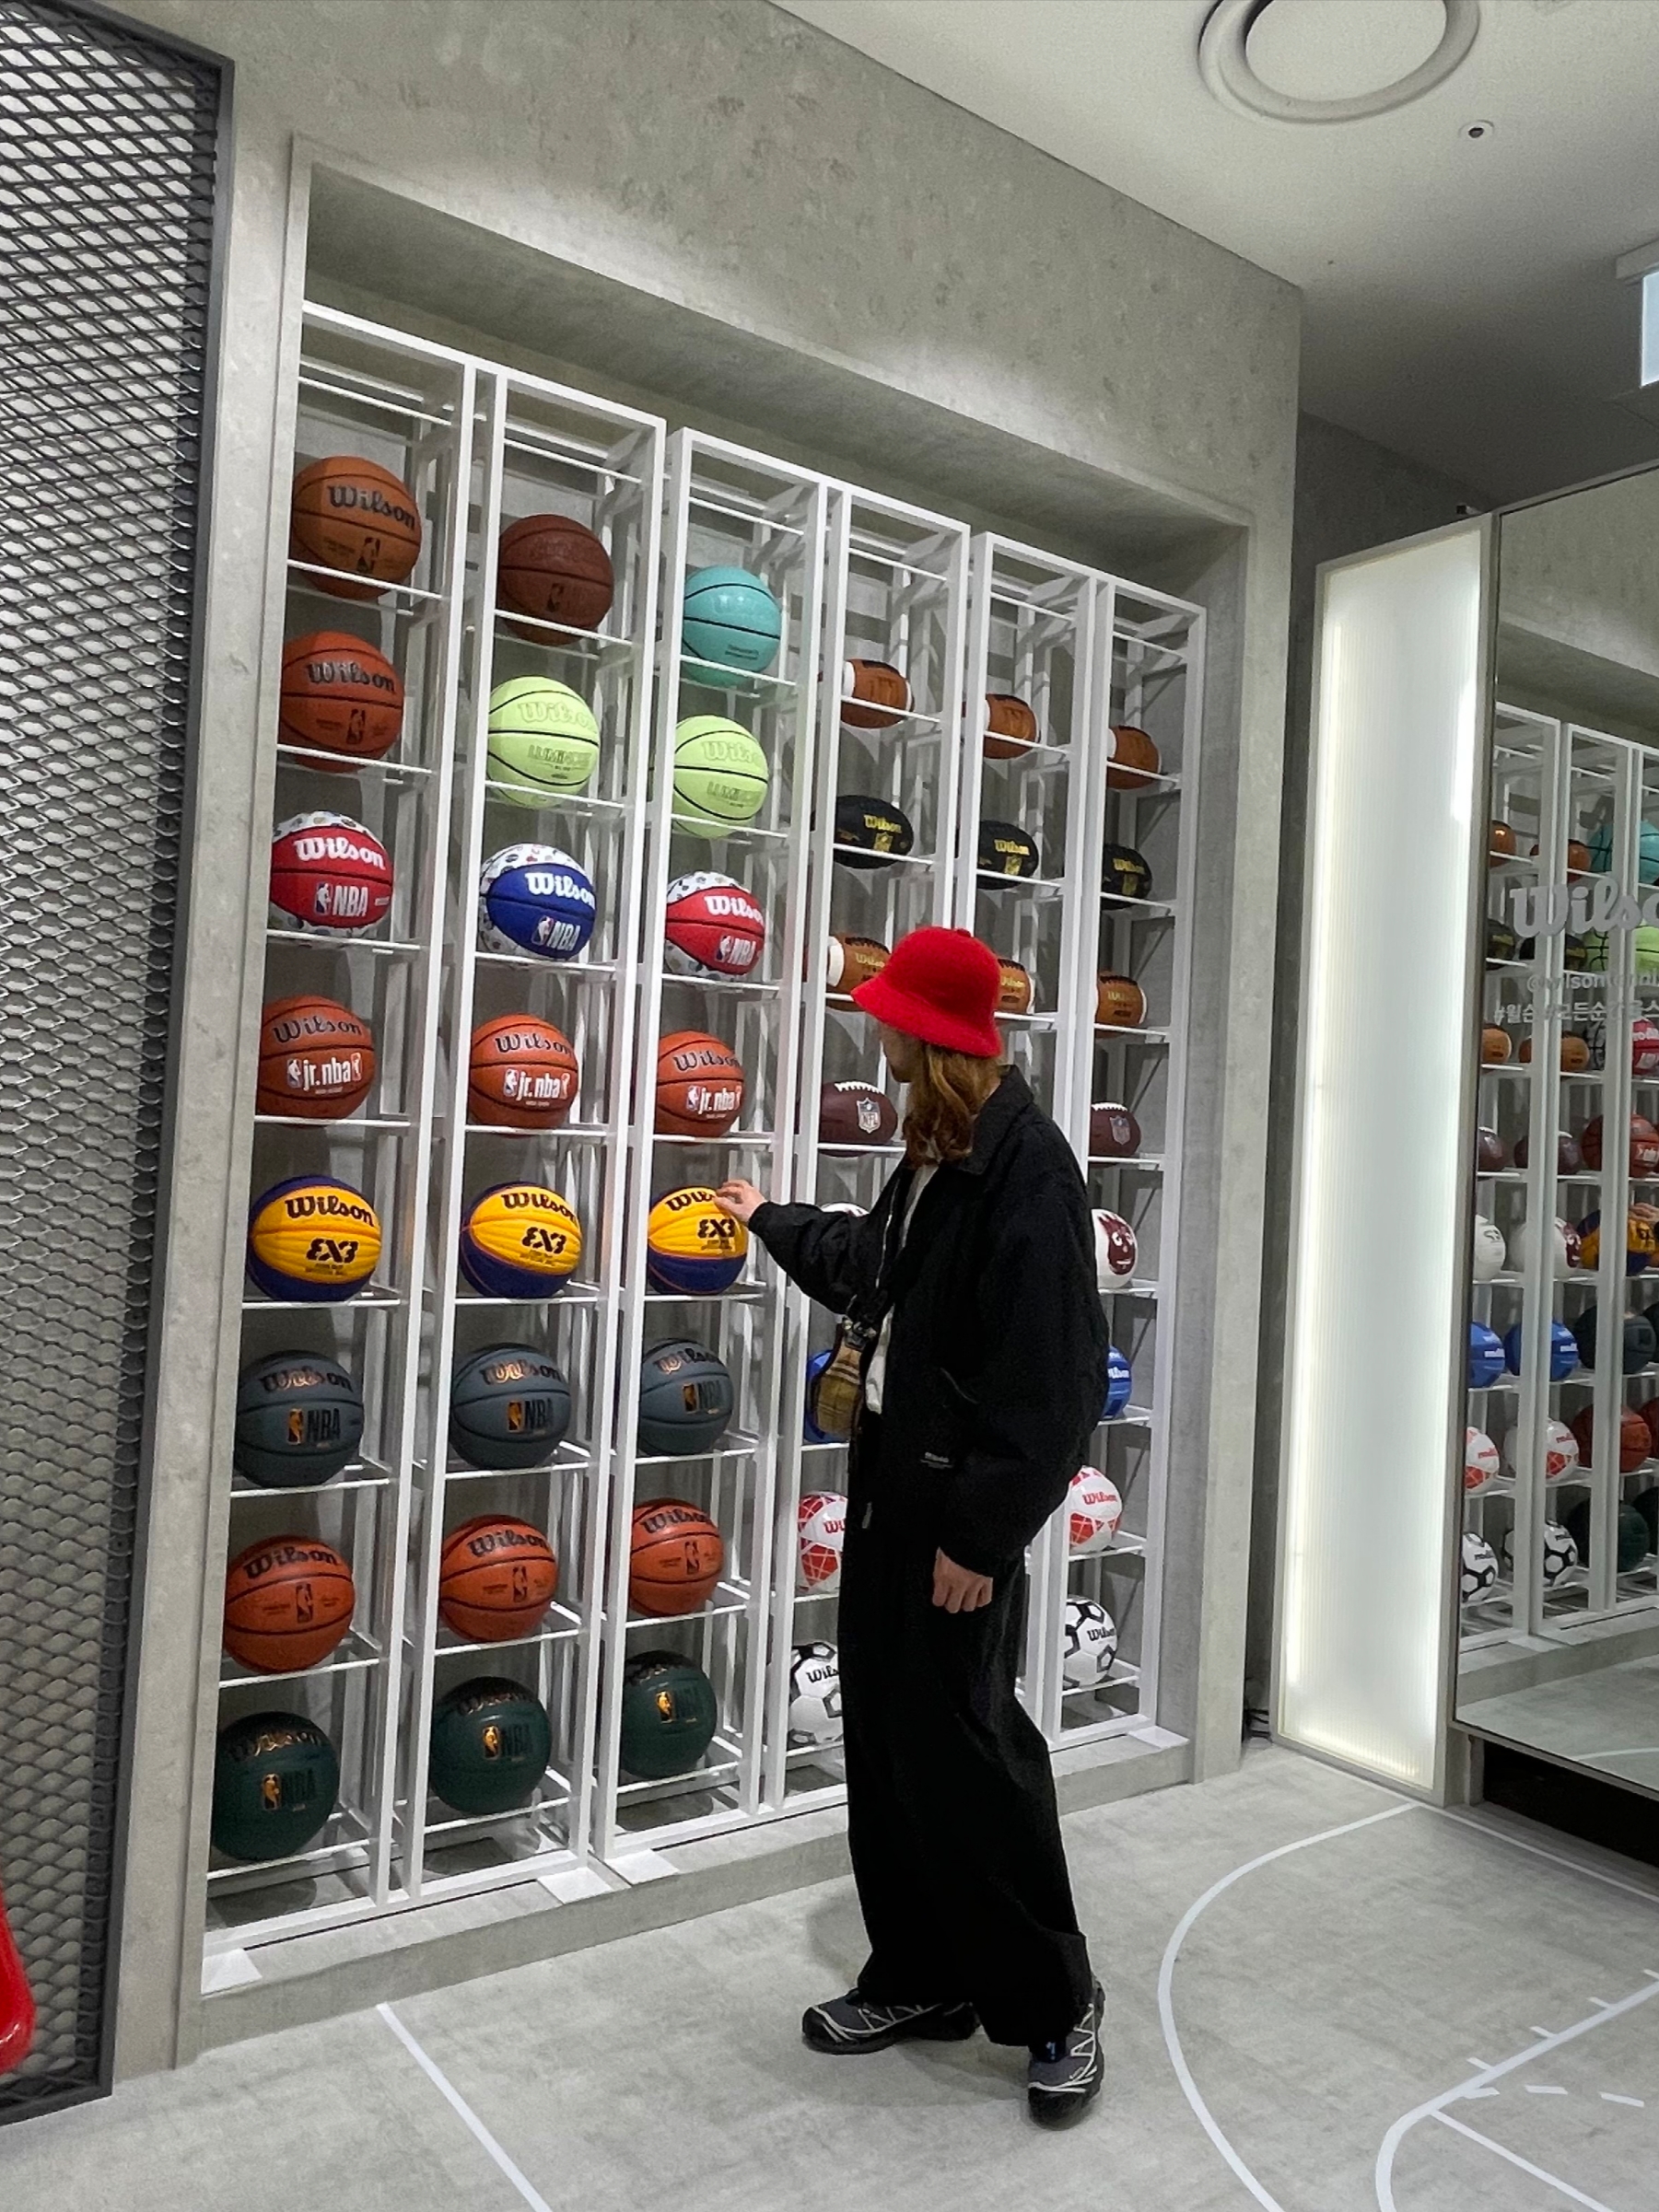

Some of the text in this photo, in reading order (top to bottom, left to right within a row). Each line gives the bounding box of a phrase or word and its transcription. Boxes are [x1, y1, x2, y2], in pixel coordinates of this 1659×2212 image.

[327, 485, 415, 529] Wilson
[306, 660, 395, 693] Wilson
[294, 837, 386, 870] Wilson
[333, 885, 368, 917] NBA
[547, 920, 581, 951] NBA
[274, 1016, 362, 1042] Wilson
[285, 1195, 374, 1227] Wilson
[307, 1408, 341, 1441] NBA
[1082, 1491, 1117, 1506] Wilson
[467, 1530, 550, 1557] Wilson
[243, 1546, 338, 1578] Wilson
[805, 1665, 839, 1683] Wils
